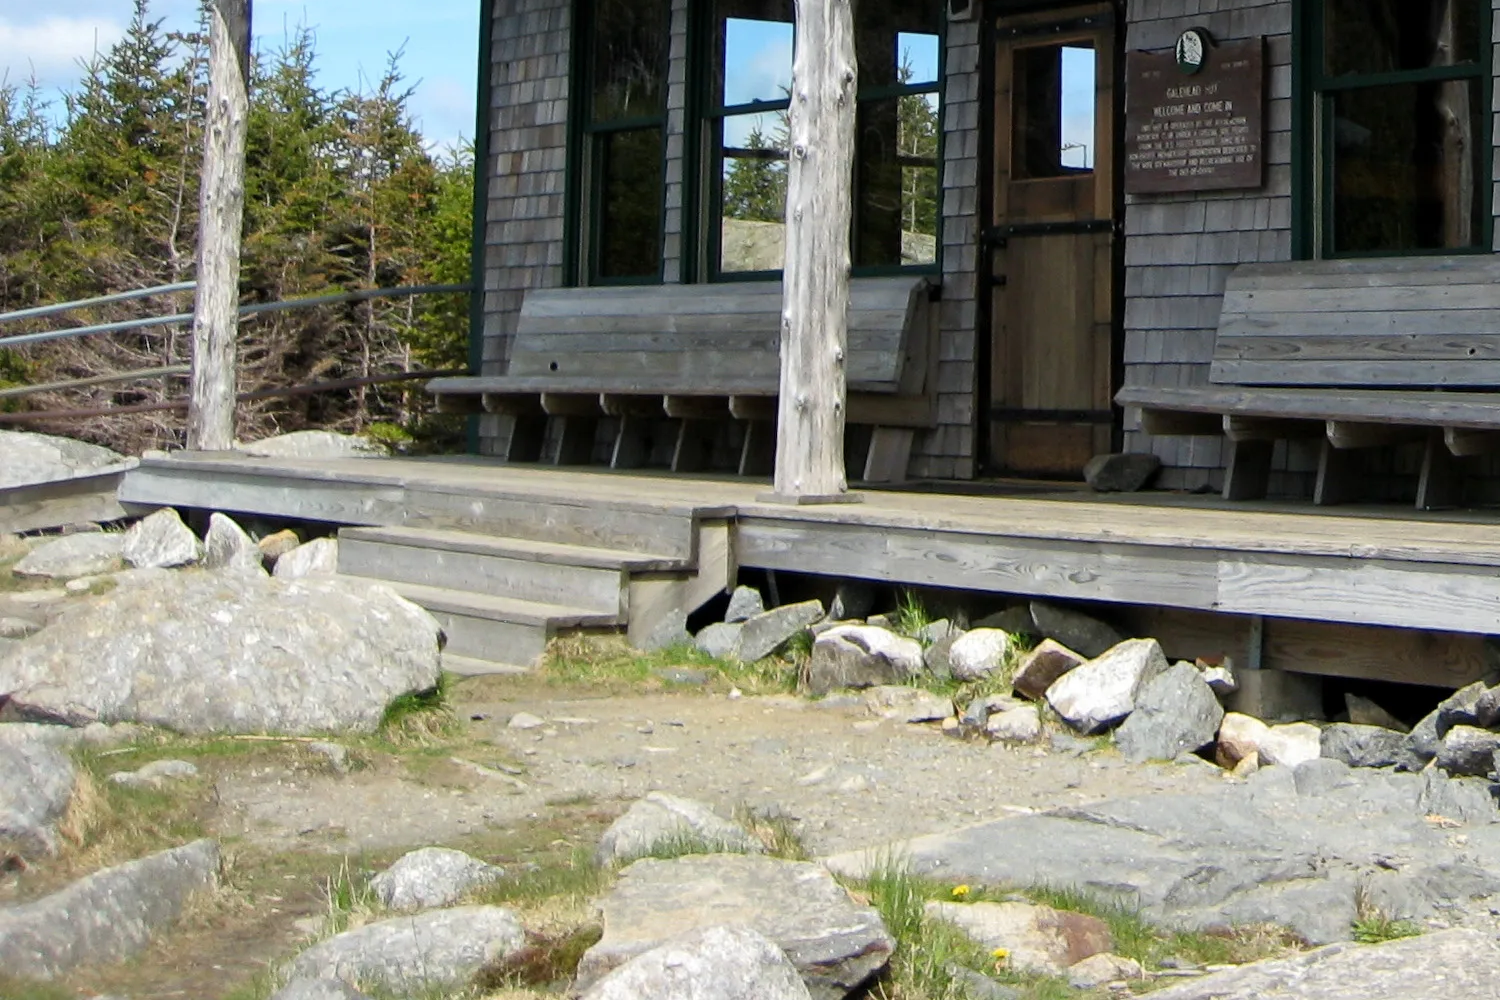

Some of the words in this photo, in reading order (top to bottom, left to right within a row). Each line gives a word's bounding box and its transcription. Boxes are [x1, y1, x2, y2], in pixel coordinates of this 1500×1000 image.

[1166, 85, 1201, 99] GALEHEAD
[1153, 104, 1185, 118] WELCOME
[1187, 102, 1202, 115] AND
[1203, 101, 1223, 113] COME
[1225, 100, 1234, 111] IN
